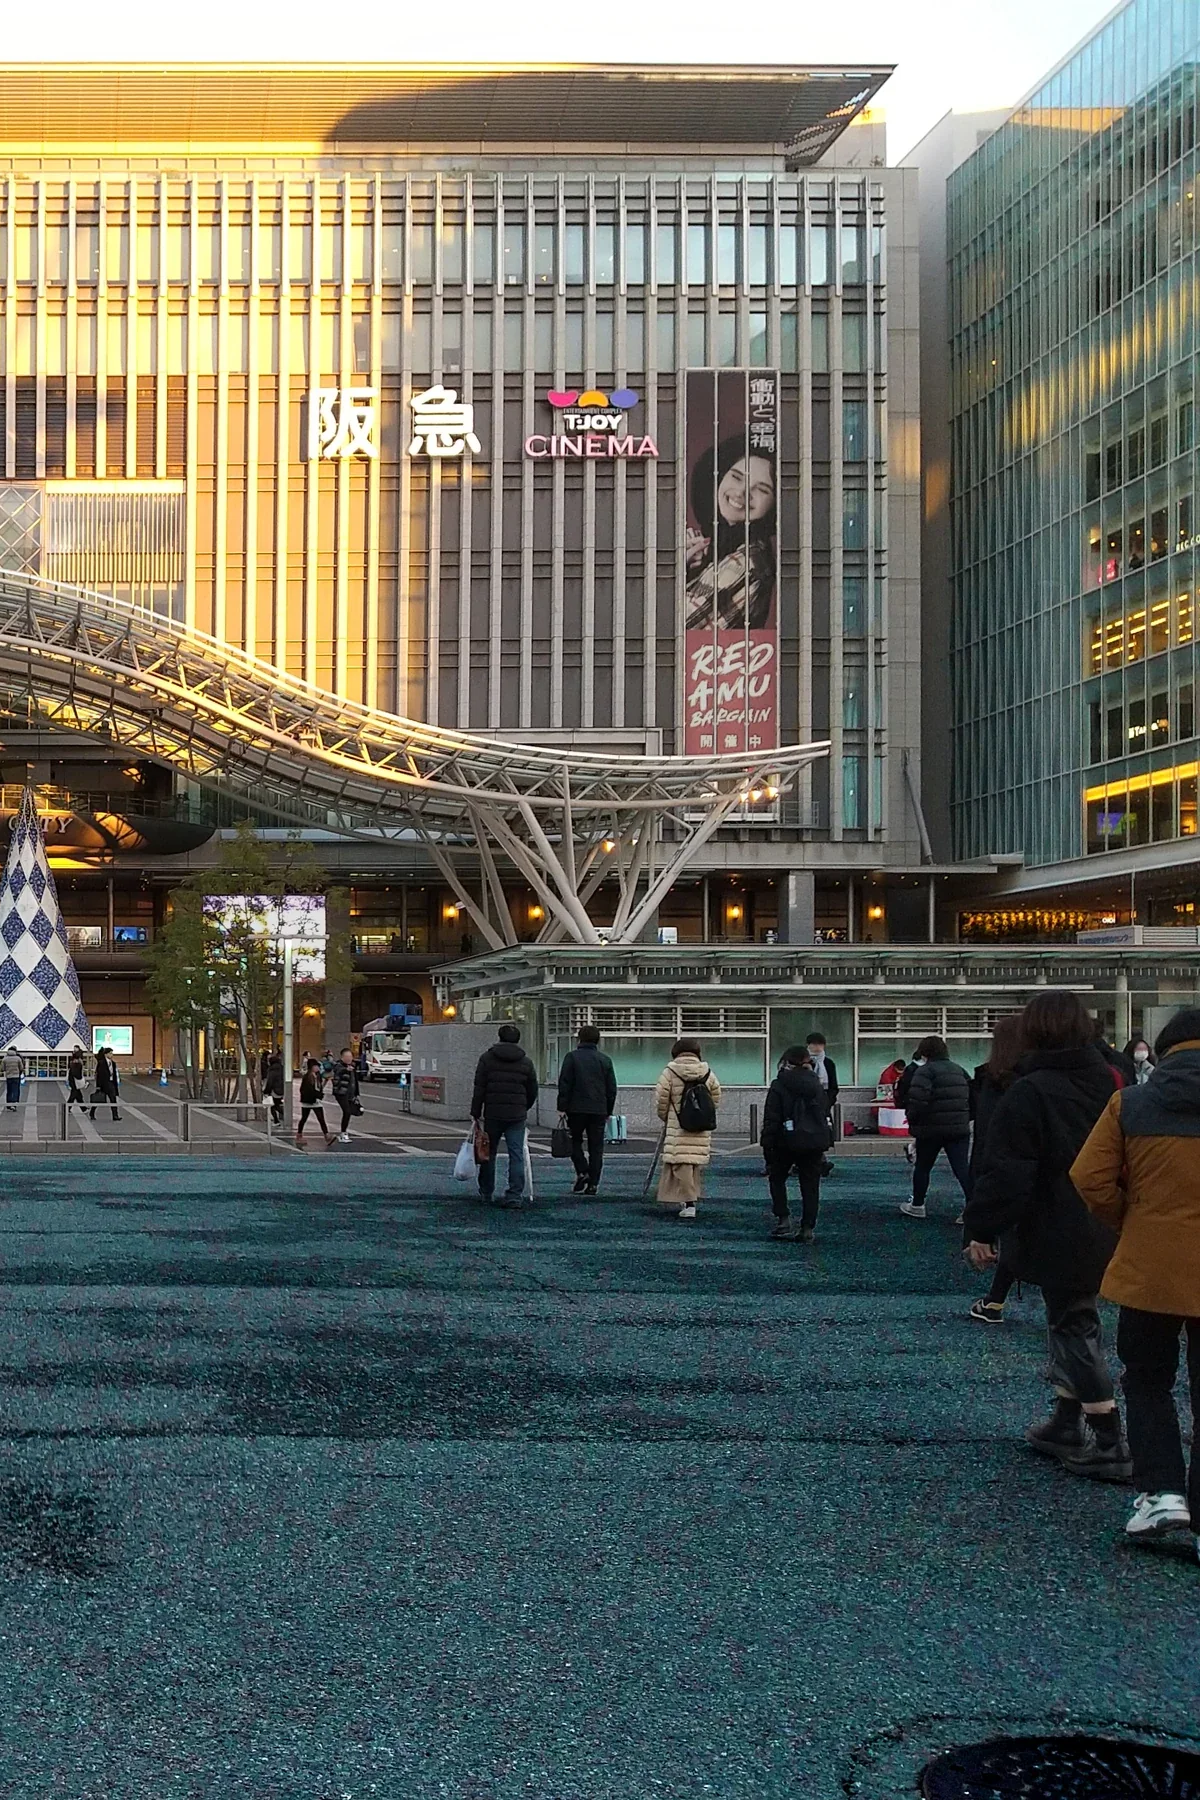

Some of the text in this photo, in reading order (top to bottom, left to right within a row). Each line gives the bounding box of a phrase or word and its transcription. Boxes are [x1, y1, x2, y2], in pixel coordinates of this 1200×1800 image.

[308, 385, 482, 460] 阪急
[524, 434, 660, 457] CINEMA
[691, 640, 775, 681] RED
[688, 674, 771, 711] AMU
[690, 707, 772, 727] BARGAIN
[8, 815, 74, 834] CTY
